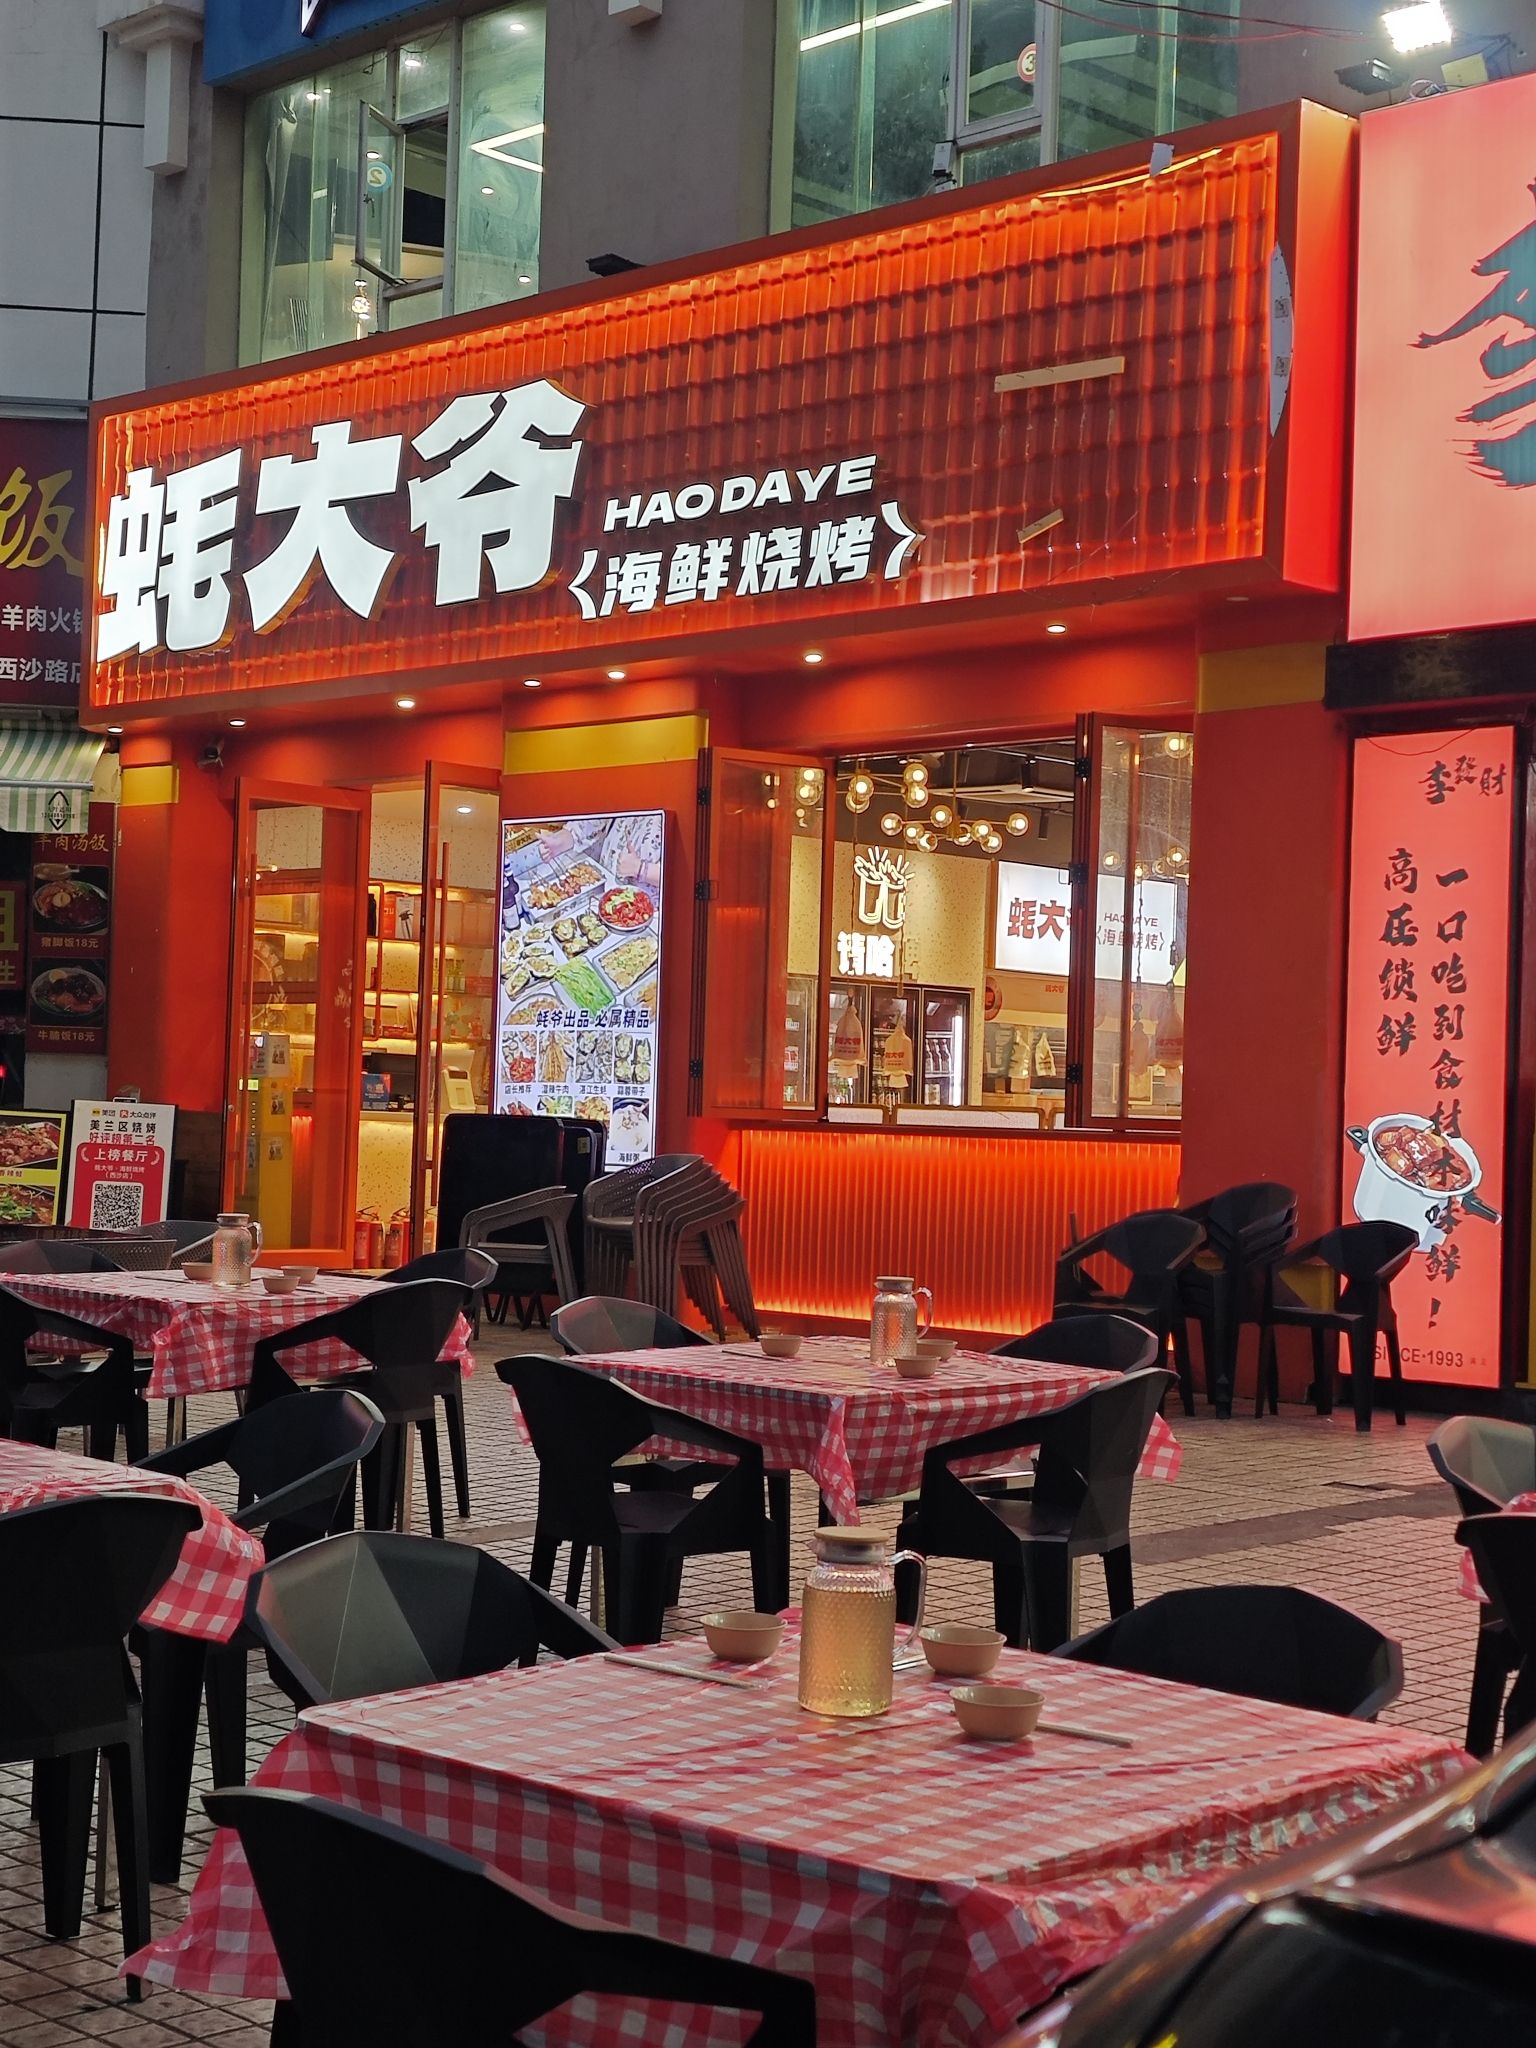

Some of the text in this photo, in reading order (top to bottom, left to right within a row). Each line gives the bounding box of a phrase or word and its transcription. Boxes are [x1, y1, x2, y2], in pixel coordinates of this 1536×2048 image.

[603, 454, 877, 532] HAODAYE
[0, 466, 83, 578] 饭
[97, 378, 586, 663] 蚝大爷
[1007, 897, 1072, 941] 蚝大
[536, 1008, 650, 1028] 蚝爷出品 必属精品
[89, 1119, 157, 1134] 美兰区烧烤
[94, 1148, 148, 1162] 上榜餐厅
